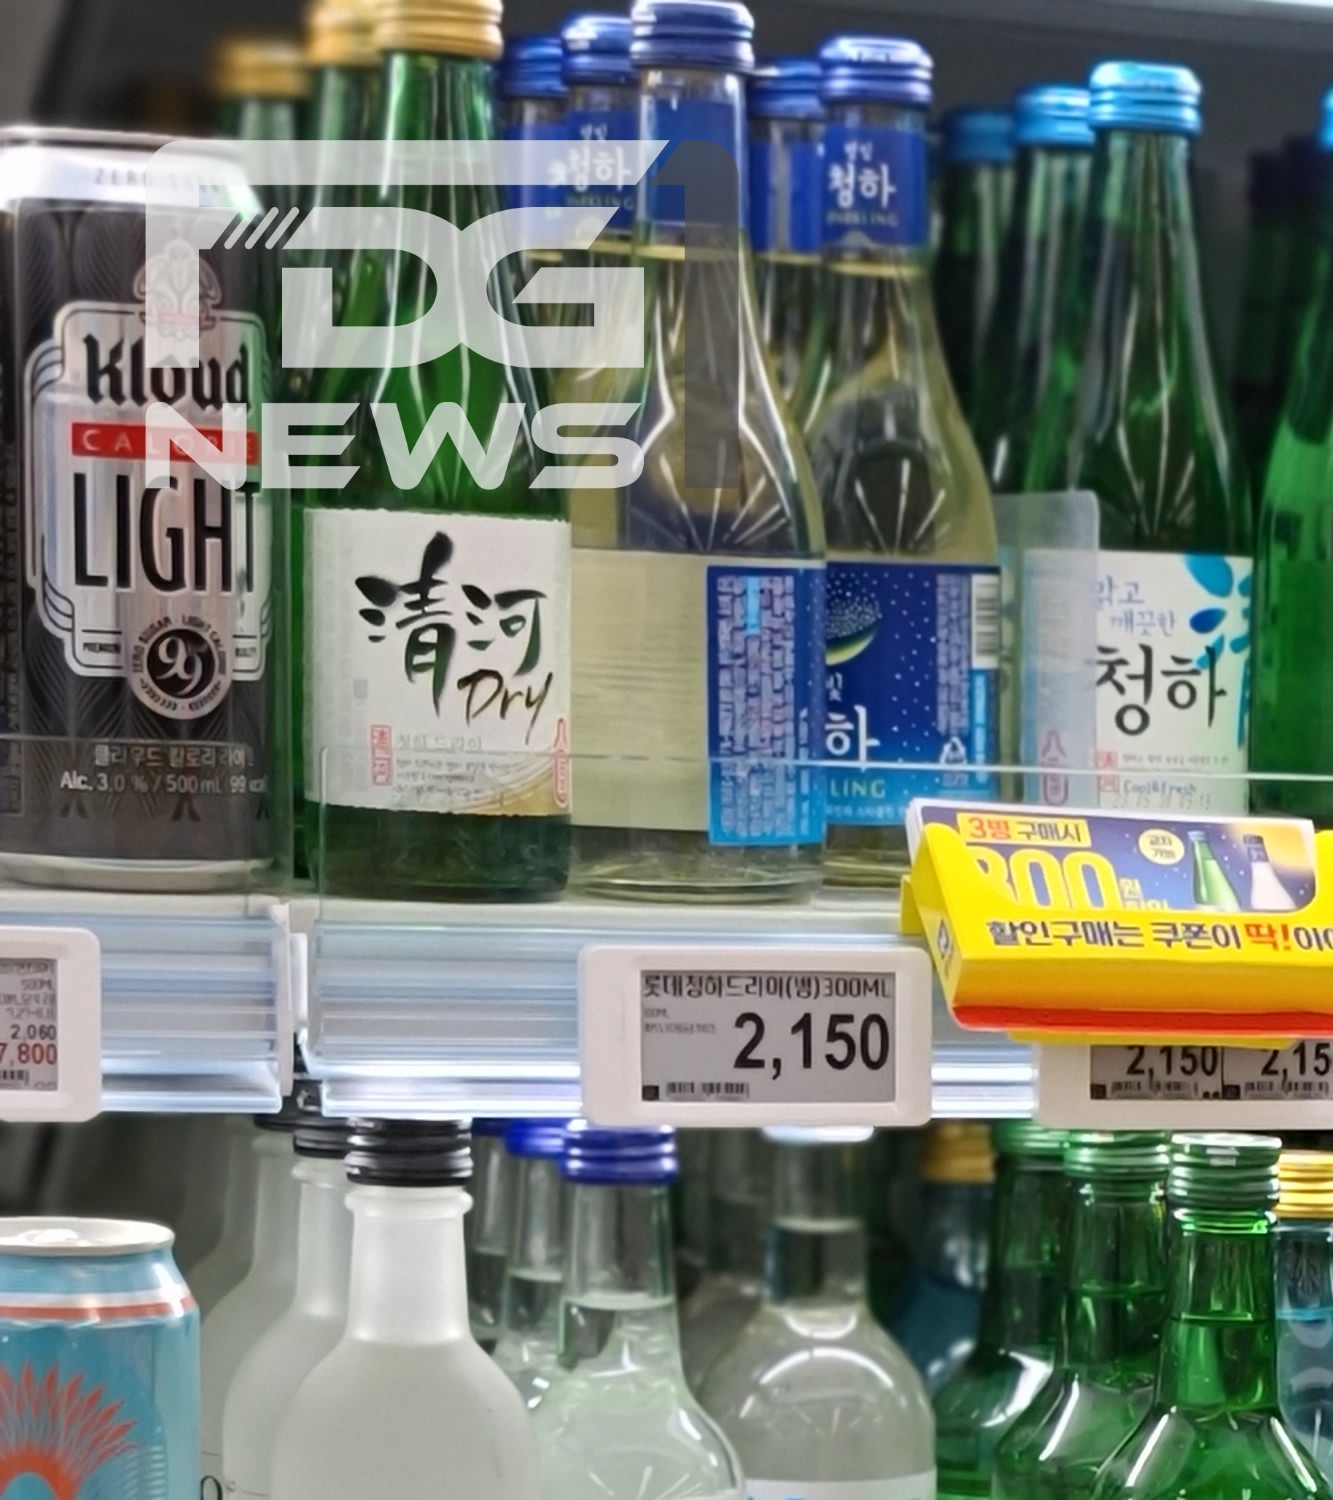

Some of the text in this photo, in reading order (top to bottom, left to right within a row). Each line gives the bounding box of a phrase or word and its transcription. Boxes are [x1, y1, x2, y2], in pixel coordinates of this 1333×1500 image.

[828, 164, 896, 209] 청하
[83, 333, 252, 412] Kloud
[82, 429, 254, 462] CALORIE
[73, 473, 262, 595] LIGHT
[456, 668, 554, 745] Dry
[1085, 642, 1228, 736] 청하
[968, 816, 1082, 843] 3병 구매시
[986, 919, 1146, 948] 할인구매는
[1152, 921, 1239, 950] 쿠폰이
[732, 1011, 890, 1081] 2,150
[1126, 1045, 1219, 1088] 2,150
